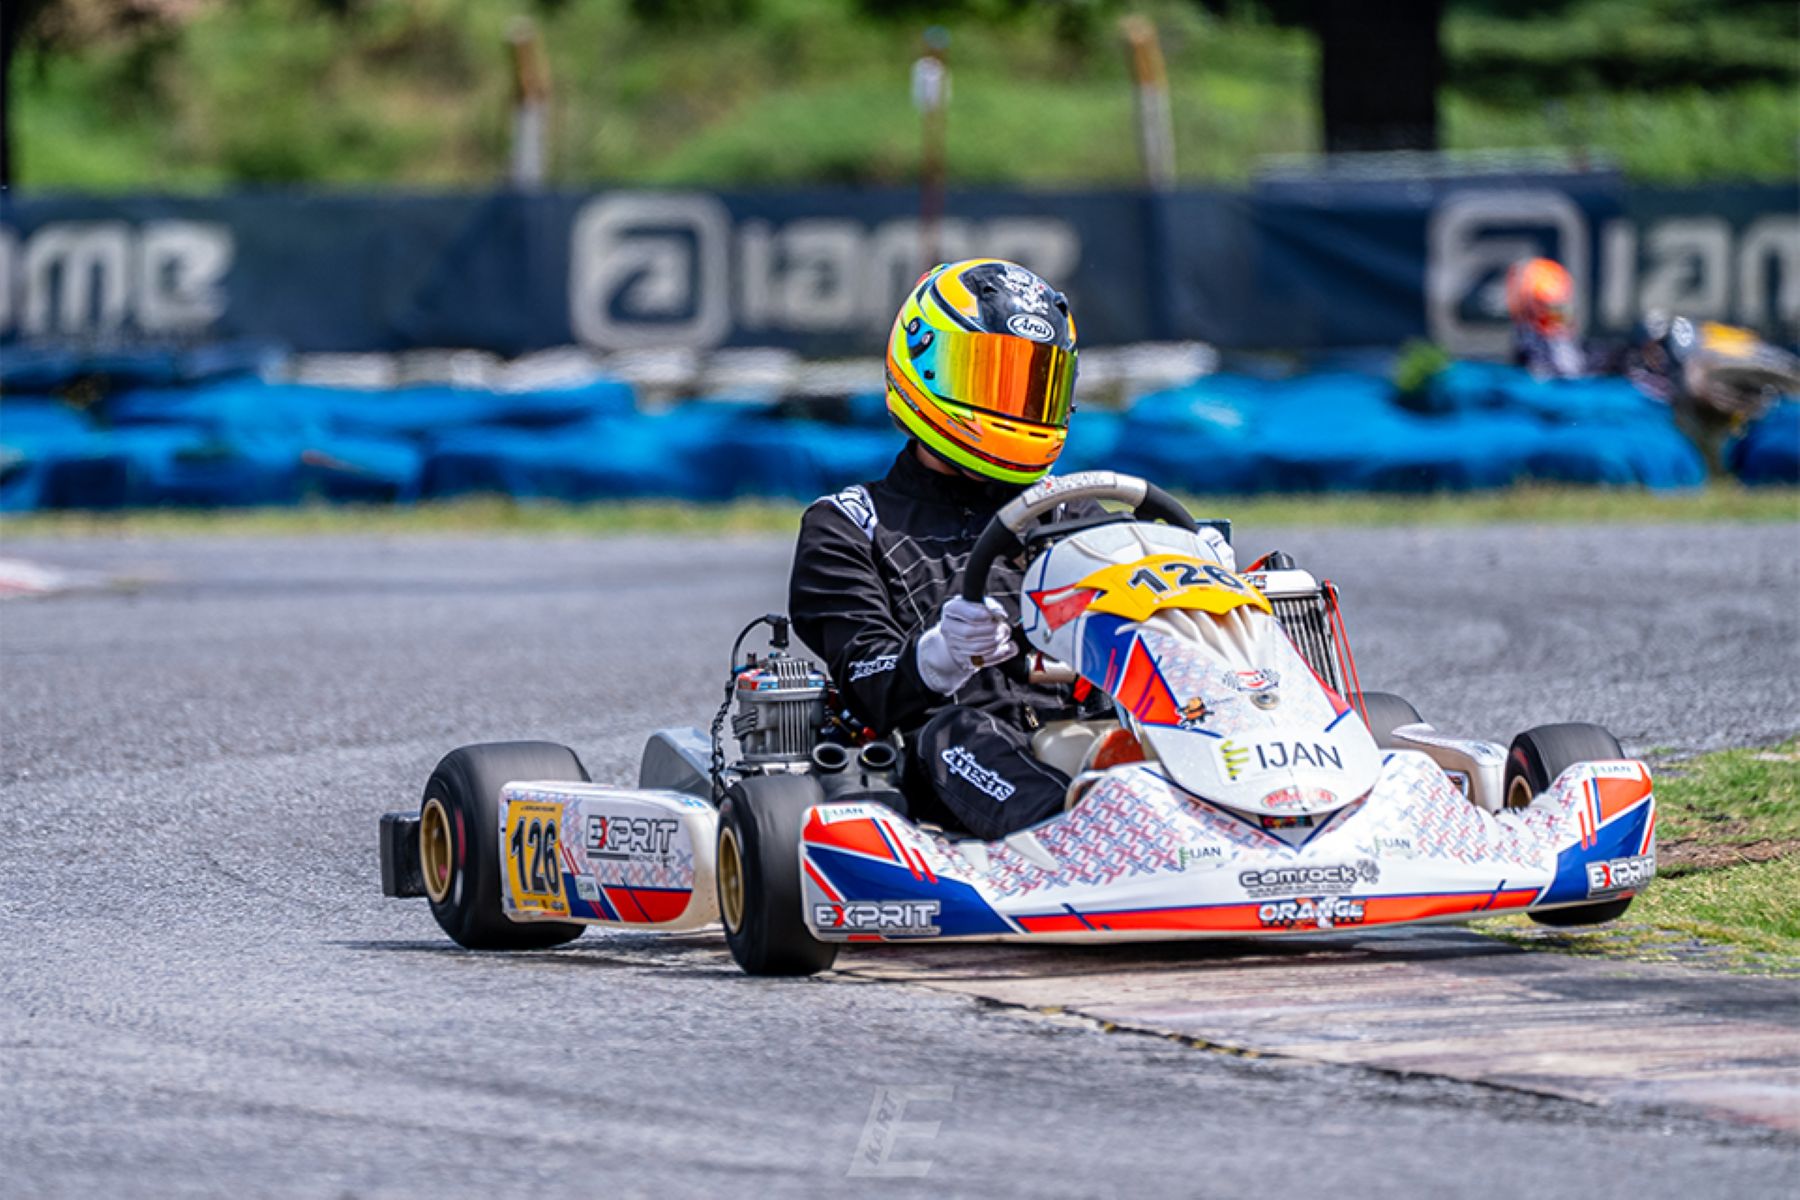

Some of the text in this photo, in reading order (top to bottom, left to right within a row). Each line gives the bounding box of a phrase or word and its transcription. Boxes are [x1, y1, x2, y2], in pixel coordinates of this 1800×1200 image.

[0, 221, 232, 333] me
[1013, 316, 1050, 337] Arai
[1127, 562, 1246, 595] 126
[586, 814, 679, 854] EXPRIT
[510, 815, 561, 897] 126
[814, 902, 938, 929] EXPRIT
[1257, 898, 1366, 923] ORANGE
